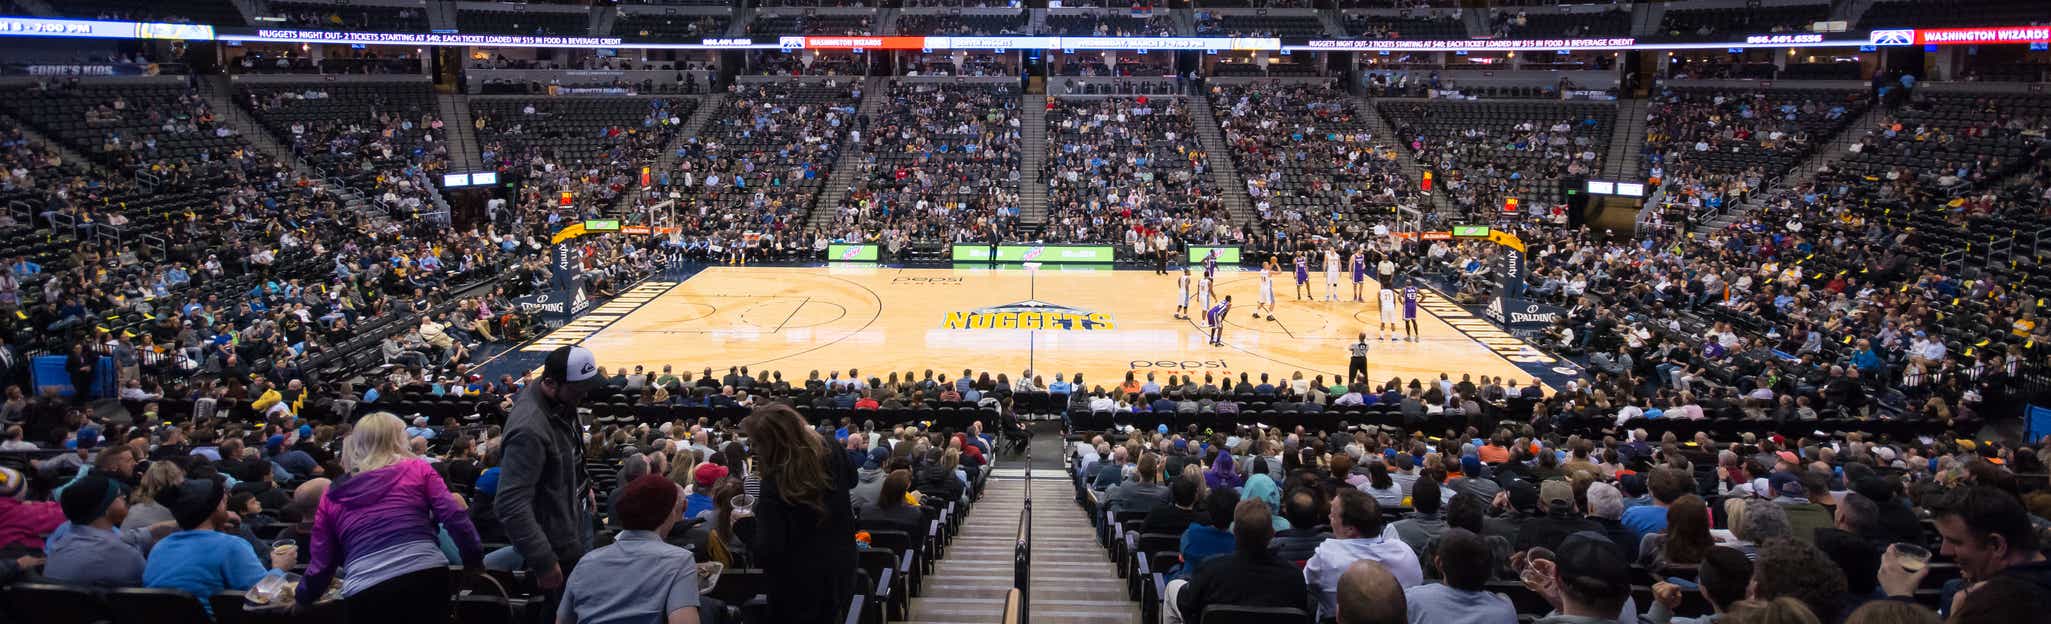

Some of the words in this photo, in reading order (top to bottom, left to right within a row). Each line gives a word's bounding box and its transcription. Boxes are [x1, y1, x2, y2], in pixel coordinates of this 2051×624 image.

[67, 23, 93, 33] PM
[1924, 30, 1996, 41] WASHINGTON
[1997, 29, 2049, 40] WIZARDS
[259, 29, 297, 38] NUGGETS
[299, 31, 323, 39] NIGHT
[344, 32, 349, 40] 2
[350, 32, 379, 41] TICKETS
[380, 33, 415, 41] STARTING
[463, 35, 484, 43] TICKET
[522, 36, 534, 44] $15
[568, 37, 599, 45] BEVERAGE
[1309, 40, 1335, 48] NUGGETS
[1336, 40, 1353, 48] NIGHT
[1373, 40, 1395, 48] TICKETS
[1395, 40, 1423, 48] STARTING
[1447, 40, 1464, 48] EACH
[1465, 40, 1486, 48] TICKET
[1571, 39, 1607, 47] BEVERAGE
[1608, 38, 1635, 46] CREDIT
[559, 242, 568, 271] xfinity
[1507, 249, 1518, 279] xfinity
[570, 300, 590, 314] adidas
[941, 310, 1116, 330] NUGGETS
[1130, 359, 1228, 369] pepsi
